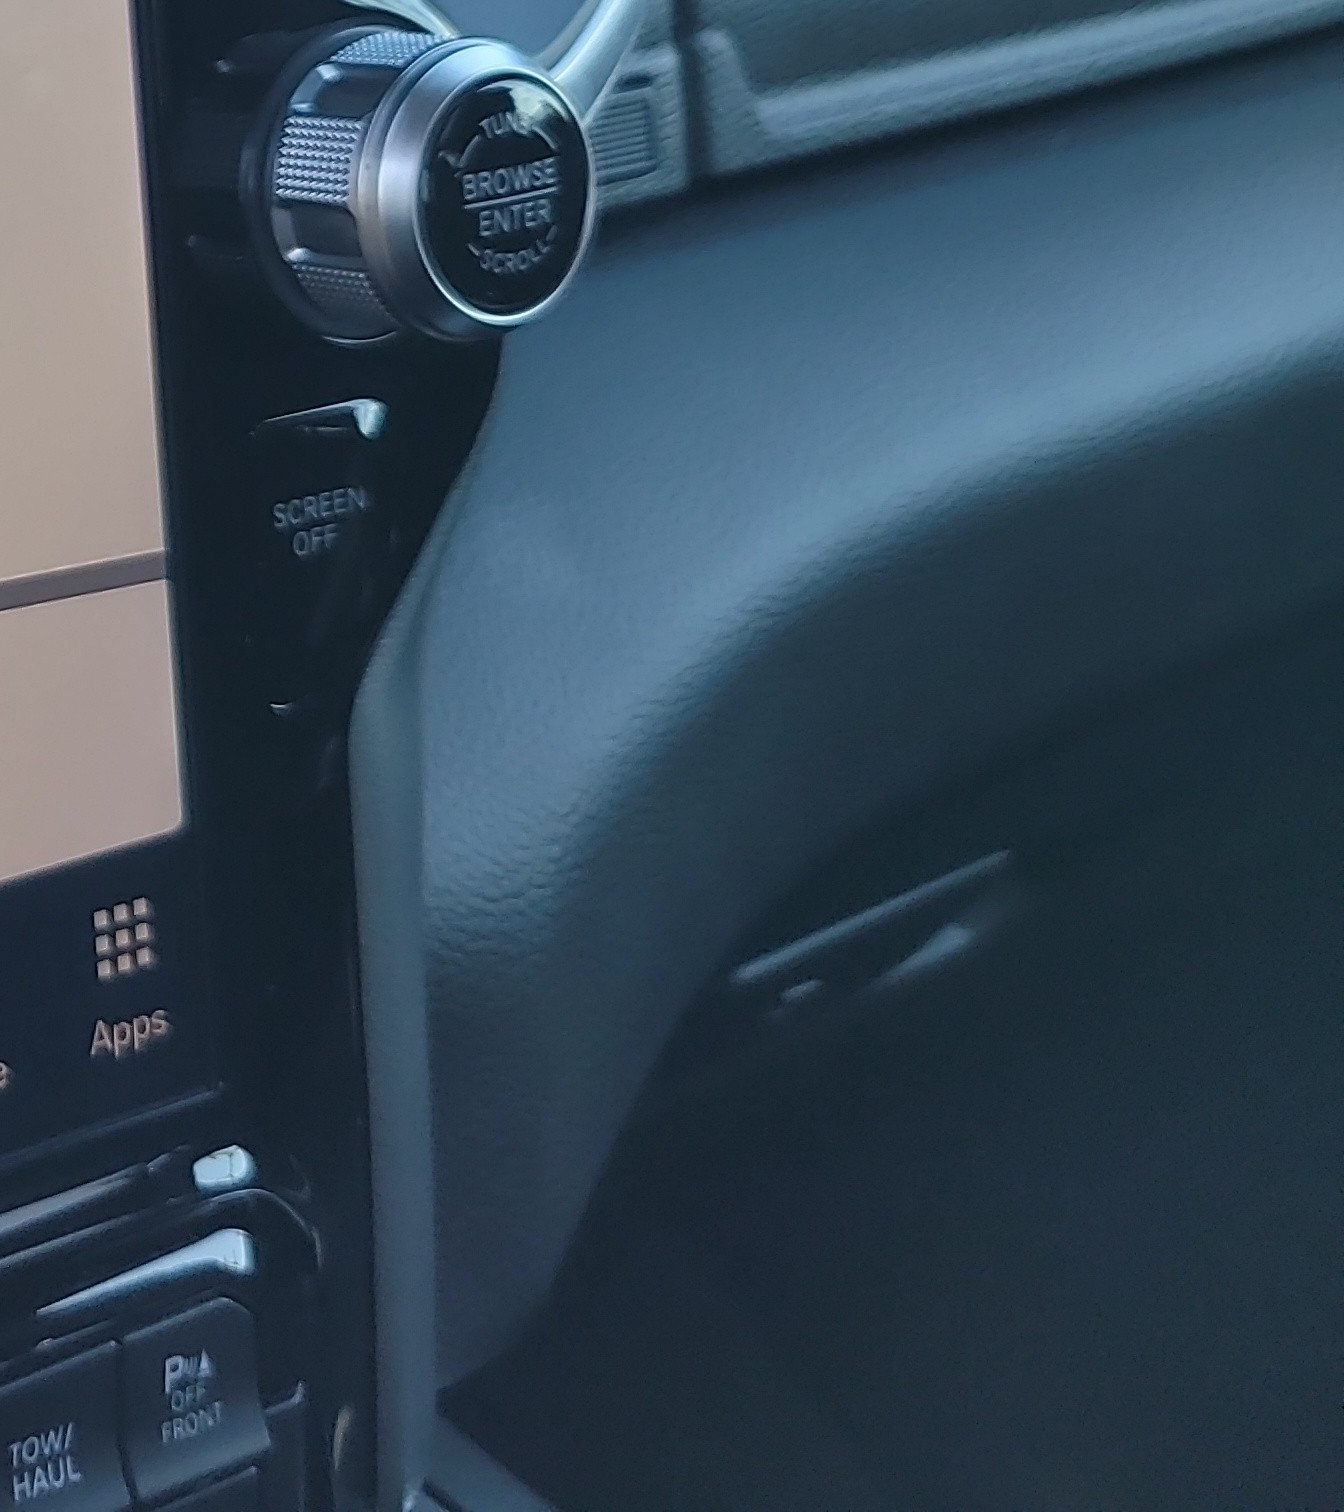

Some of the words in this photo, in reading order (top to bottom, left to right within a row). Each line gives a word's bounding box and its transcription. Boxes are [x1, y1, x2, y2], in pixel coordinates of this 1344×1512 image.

[462, 156, 560, 201] BROWSE
[478, 198, 552, 237] ENTER
[479, 239, 552, 274] SCROLL
[272, 487, 368, 529] SCREEN
[292, 522, 339, 558] OFF
[88, 1007, 173, 1062] Apps
[171, 1383, 207, 1413] OFF
[161, 1400, 223, 1444] FRONT
[8, 1421, 76, 1468] TOW/
[12, 1454, 82, 1502] HAUL
